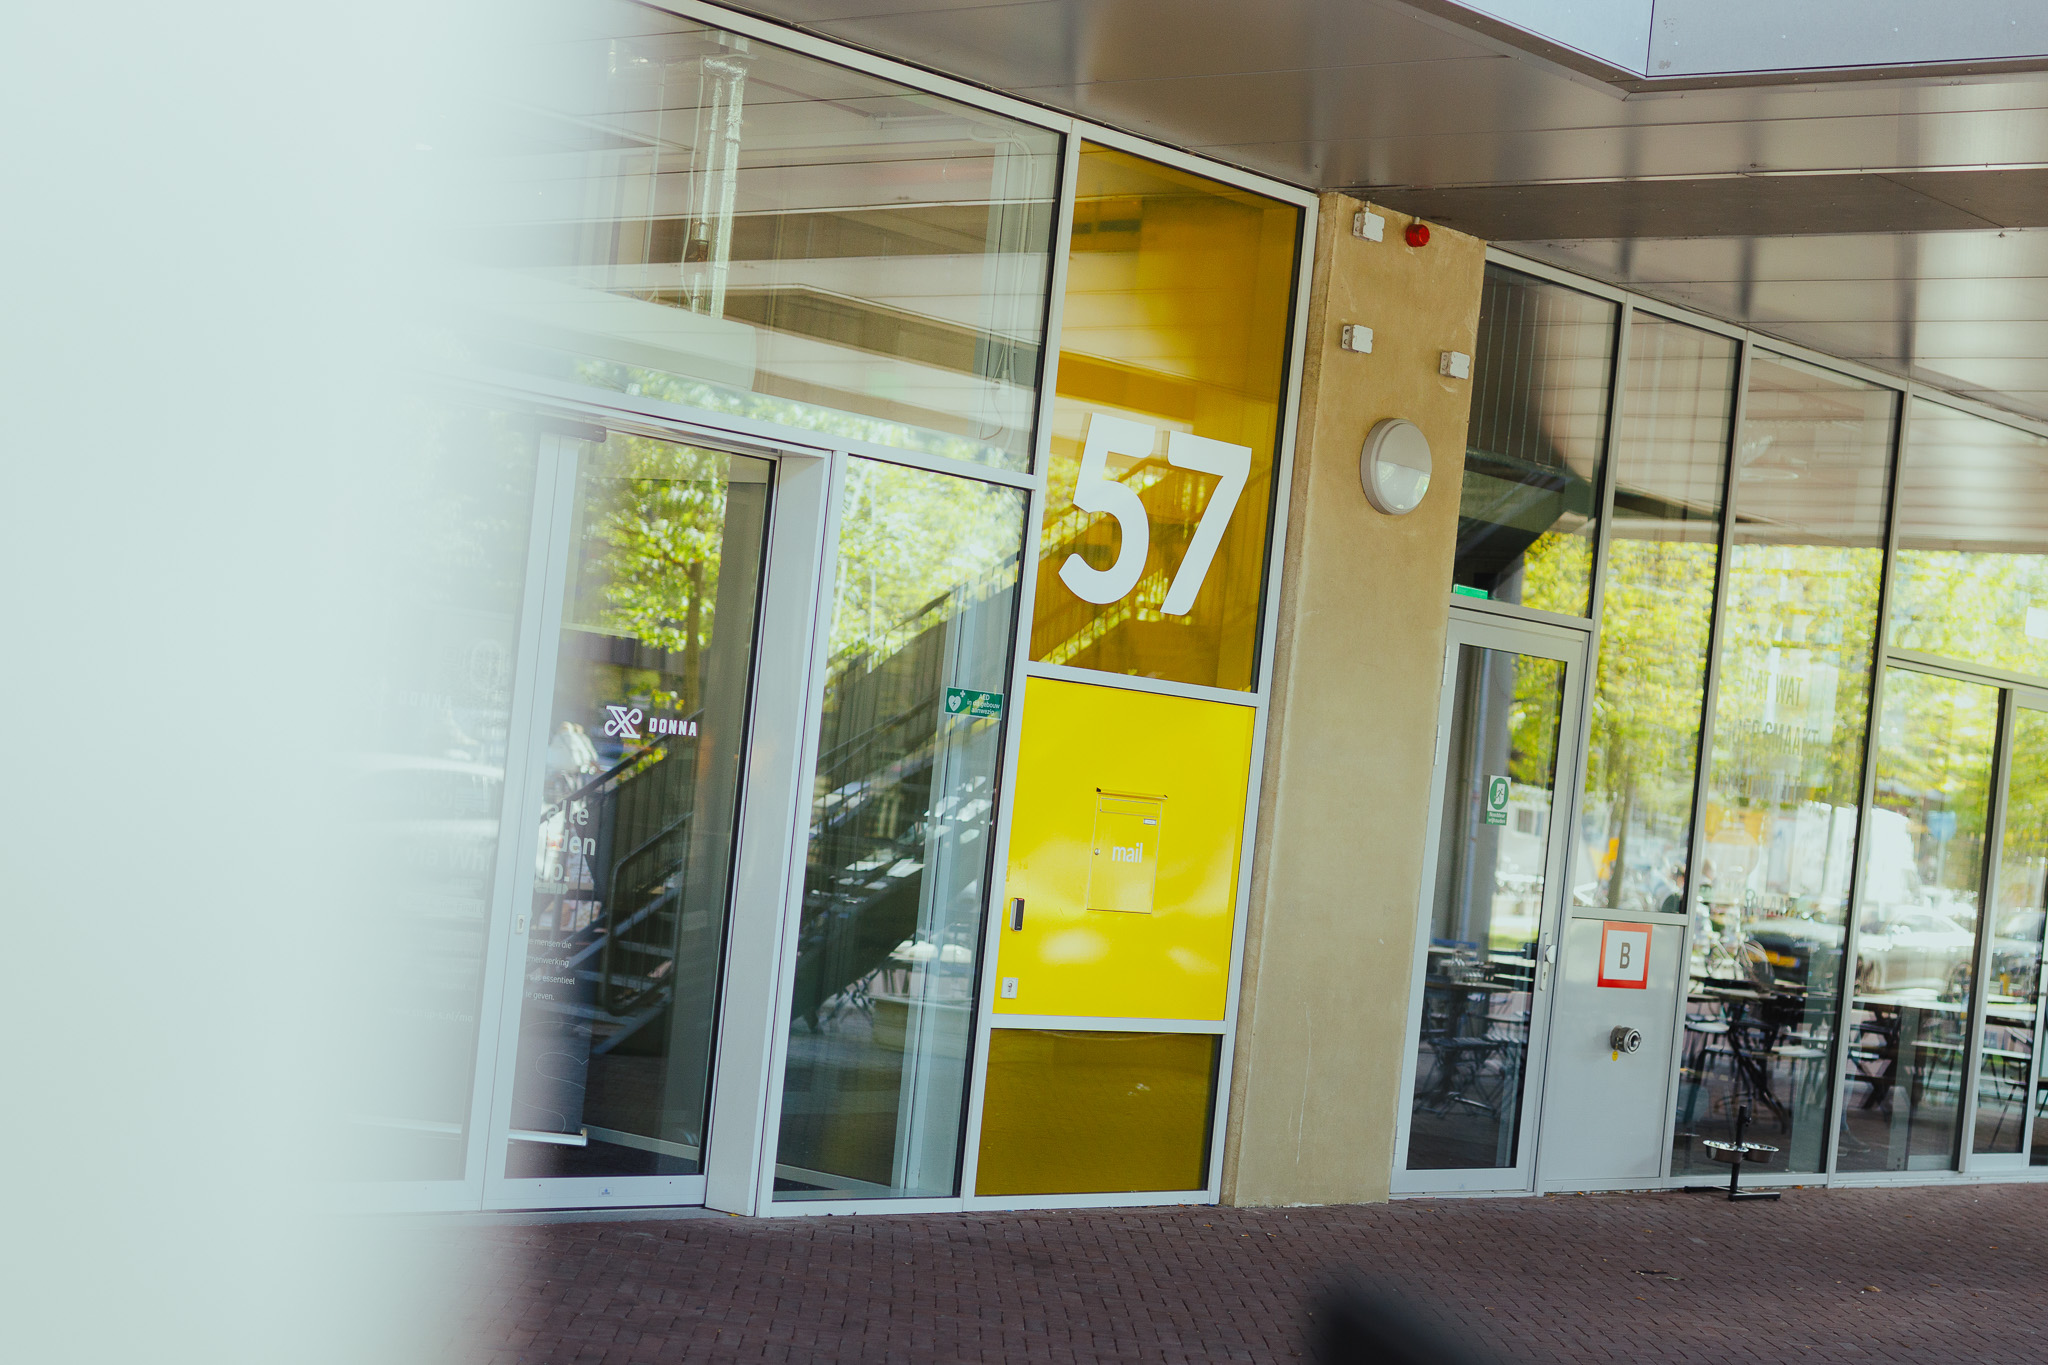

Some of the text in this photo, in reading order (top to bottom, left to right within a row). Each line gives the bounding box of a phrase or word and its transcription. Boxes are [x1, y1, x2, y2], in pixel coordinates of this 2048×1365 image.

[1058, 413, 1252, 616] 57
[979, 694, 990, 702] AED
[1776, 673, 1804, 707] WAT
[649, 717, 697, 737] DONNA
[1112, 842, 1143, 863] mail
[1620, 942, 1631, 969] B
[542, 974, 576, 985] essentieel
